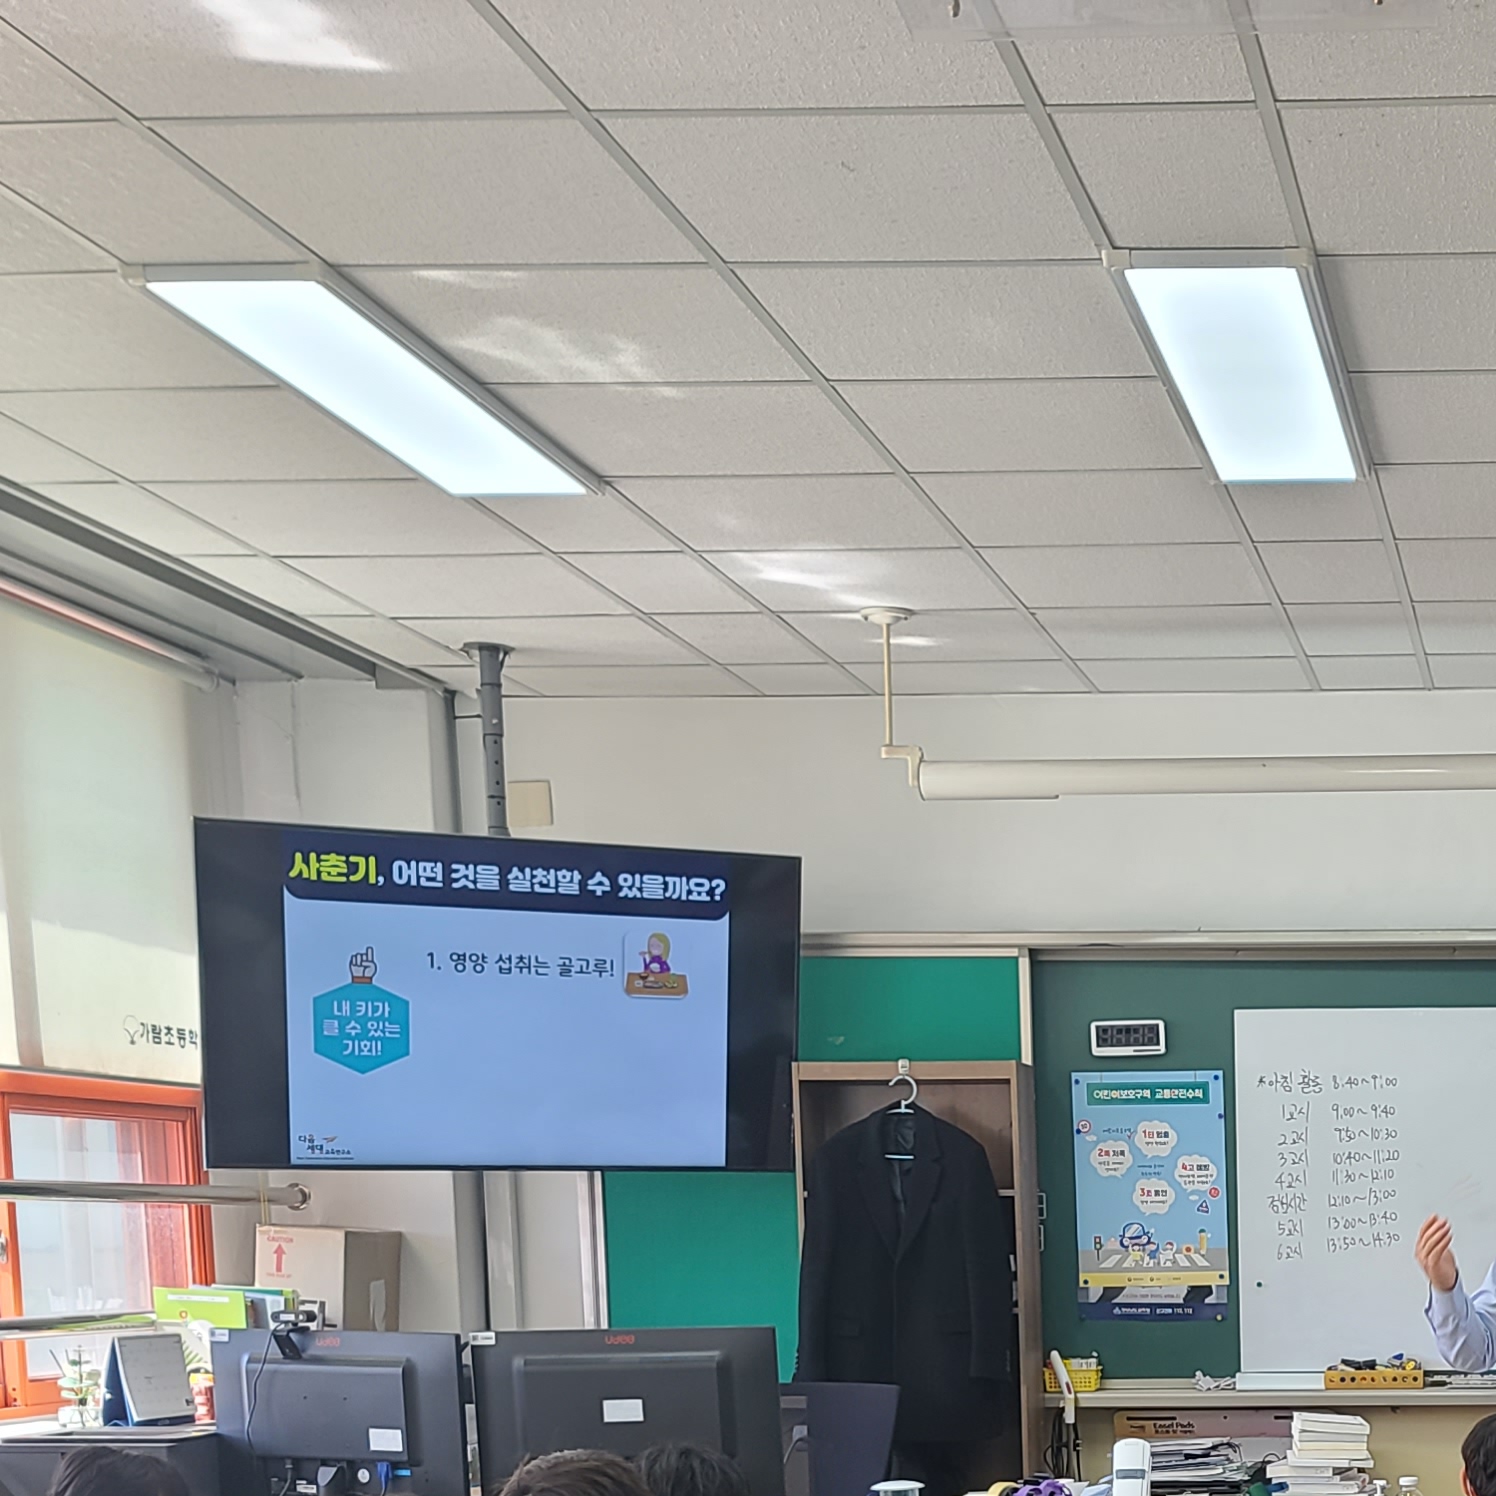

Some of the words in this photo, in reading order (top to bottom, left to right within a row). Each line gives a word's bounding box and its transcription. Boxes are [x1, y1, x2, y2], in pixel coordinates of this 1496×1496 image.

[288, 852, 385, 886] 사춘기,
[392, 860, 444, 888] 어떤
[450, 863, 500, 891] 것을
[507, 866, 582, 895] 실천할
[586, 871, 611, 896] 수
[618, 873, 727, 902] 있을까요?
[427, 952, 442, 971] 1.
[449, 952, 488, 974] 영양
[495, 953, 551, 976] 섭취는
[557, 956, 615, 979] 골고루!
[333, 1000, 350, 1017] 내
[356, 1001, 391, 1018] 키가
[345, 1020, 362, 1036] 수
[367, 1020, 401, 1038] 있는
[343, 1039, 382, 1056] 기회!
[1297, 1068, 1323, 1094] 활동
[1282, 1100, 1310, 1123] 1교시
[1277, 1126, 1308, 1146] 2교시
[1277, 1148, 1309, 1167] 3교시
[1274, 1169, 1307, 1190] 4교시
[1277, 1218, 1304, 1237] 5교시
[1277, 1241, 1303, 1260] 6교시
